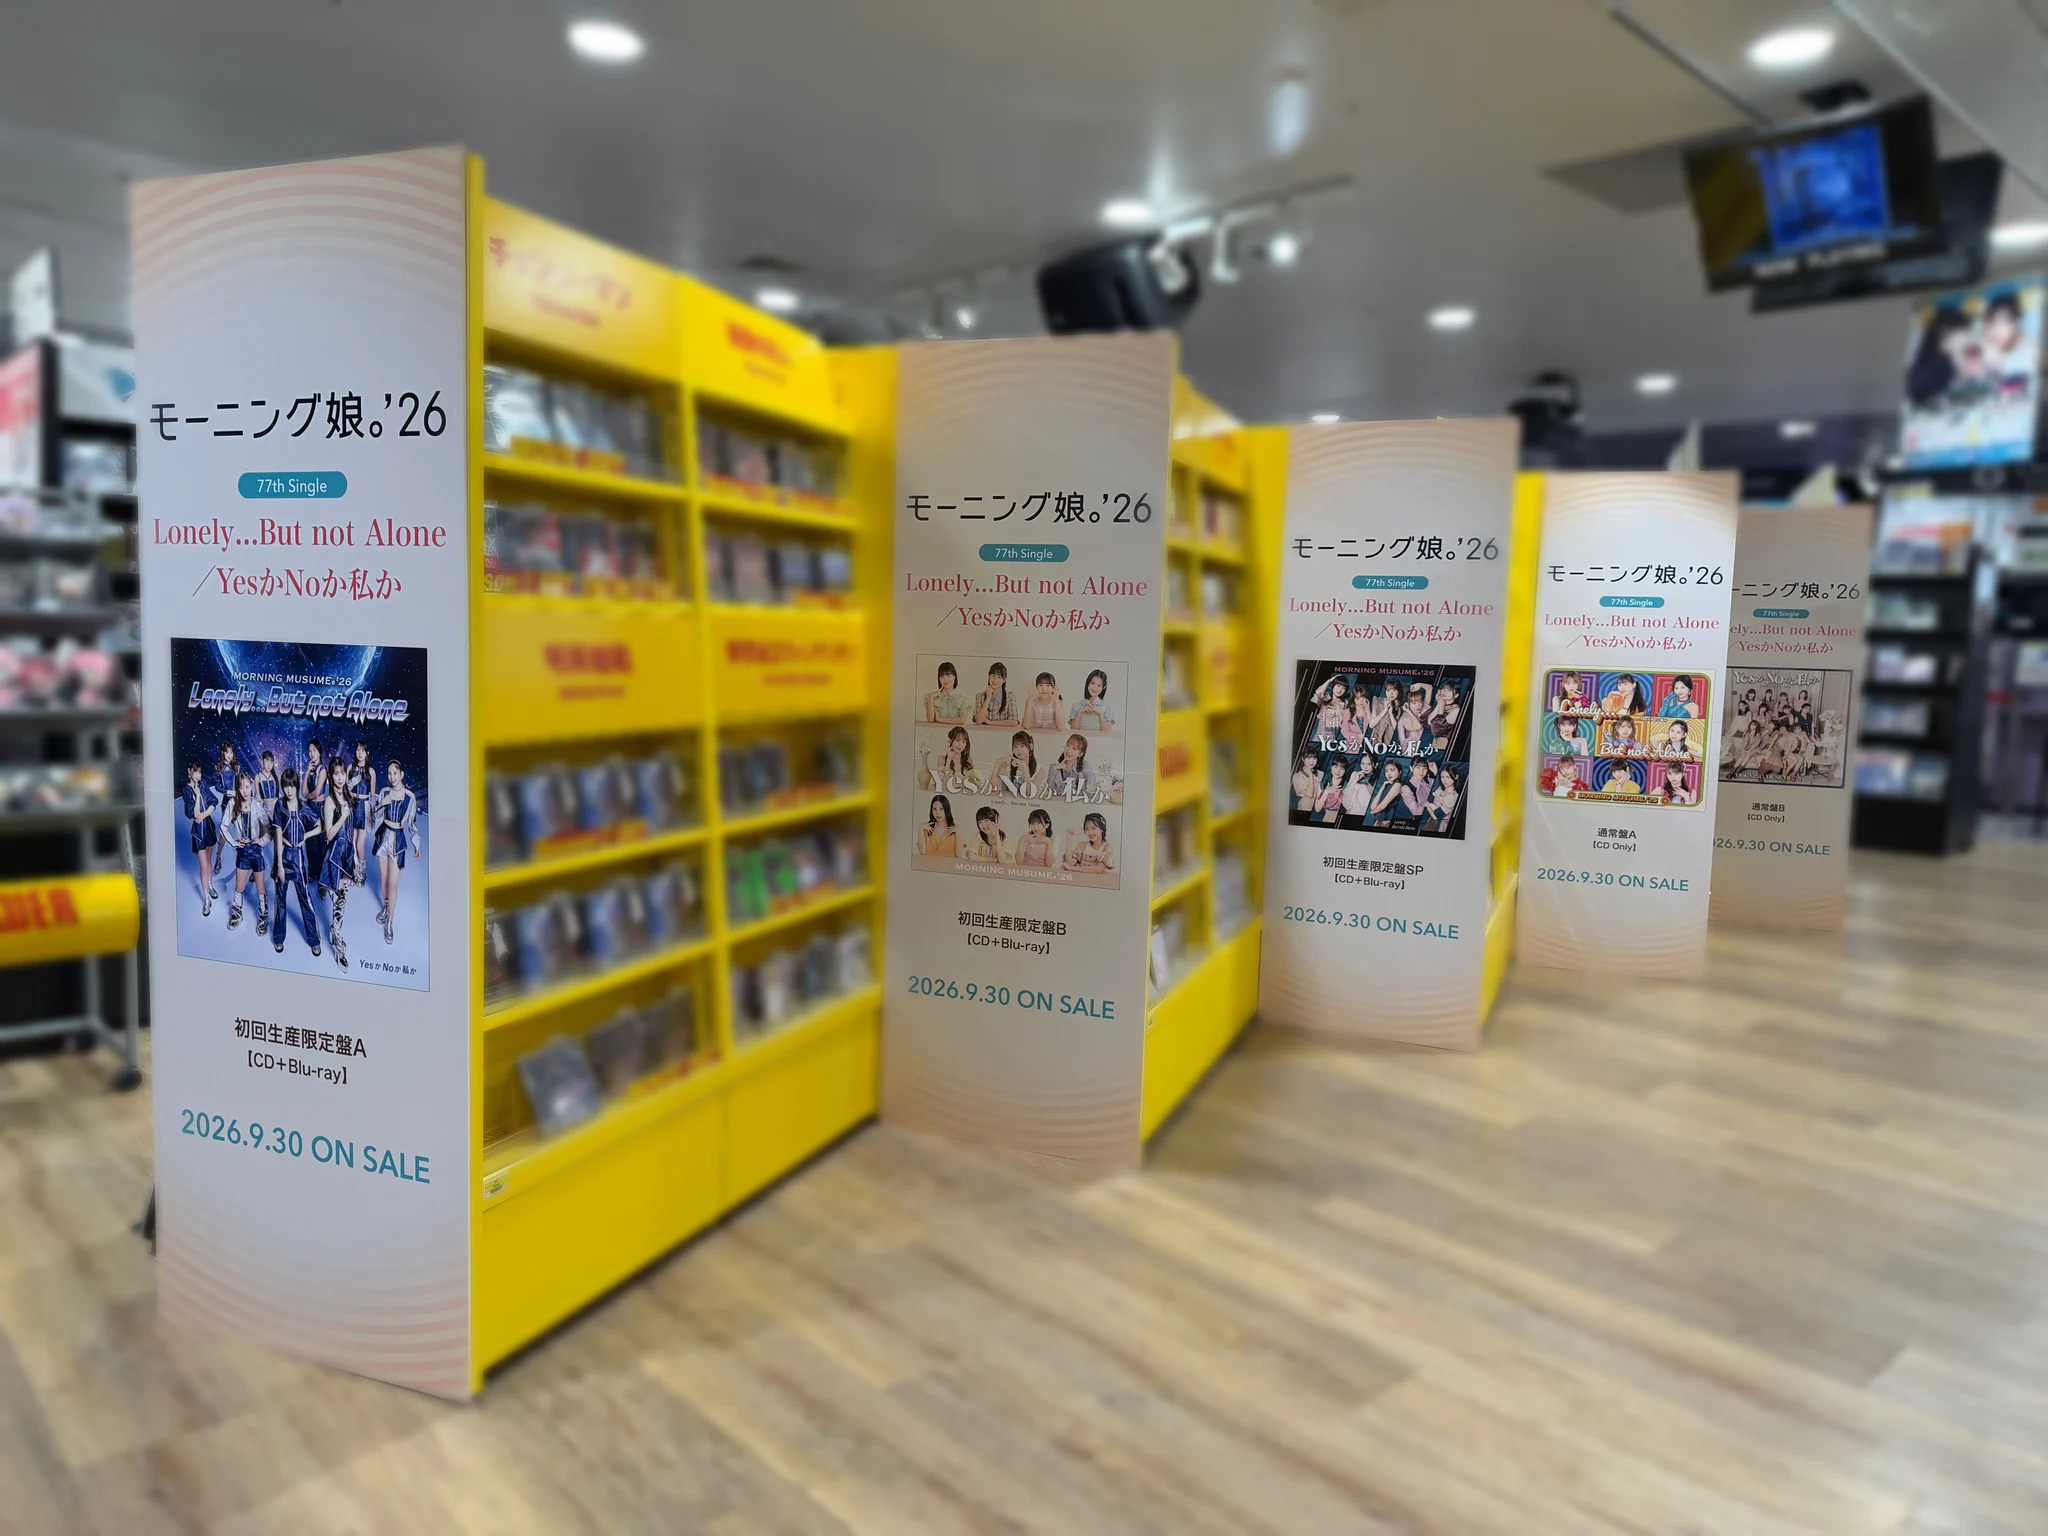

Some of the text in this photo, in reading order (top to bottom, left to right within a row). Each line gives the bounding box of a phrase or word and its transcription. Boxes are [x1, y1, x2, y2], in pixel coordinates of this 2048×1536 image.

[150, 391, 447, 441] モーニング娘。'26
[257, 479, 327, 496] 77th Single
[906, 491, 1152, 523] モーニング娘。'26
[153, 518, 447, 552] Lonely...But not Alone
[995, 548, 1053, 561] 77th Single
[1292, 535, 1499, 561] モーニング娘。'26
[192, 565, 402, 601] /YesかNoか私か
[906, 573, 1148, 597] Lonely...But not Alone
[1365, 578, 1415, 589] 77th Single
[1547, 565, 1724, 585] モーニング娘。'26
[1289, 598, 1494, 616] Lonely...But not Alone
[1629, 599, 1653, 607] Single
[937, 605, 1110, 631] /YesかNoか私か
[1545, 614, 1720, 629] Lonely...But not Alone
[1314, 622, 1462, 642] /YesかNoか私か
[1790, 626, 1811, 636] not
[1816, 625, 1857, 637] Alone
[1566, 634, 1693, 650] /YesかNoか私か
[233, 672, 283, 683] MORNING
[1334, 666, 1376, 674] MORNING
[306, 697, 348, 722] not
[346, 690, 411, 726] Alone
[1318, 734, 1438, 758] YesかNoか私か
[1600, 742, 1692, 760] But not Alone
[929, 769, 1109, 805] YesかNoか私か
[1751, 803, 1786, 812] 通常盤B
[1597, 828, 1637, 839] 通常盤A
[1713, 838, 1830, 856] 26.9.30 ON SALE
[956, 863, 1004, 875] MORNING
[1322, 856, 1424, 876] 初回生産限定盤SP
[1537, 868, 1689, 891] 2026.9.30 ON SALE
[957, 911, 1067, 936] 初回生産限定盤B
[1283, 906, 1459, 939] 2026.9.30 ON SALE
[359, 959, 417, 976] YesかNoか私か
[908, 976, 1115, 1020] 2026.9.30 ON SALE
[234, 1017, 367, 1058] 初回生産限定盤A
[181, 1109, 430, 1184] 2026.9.30 ON SALE
